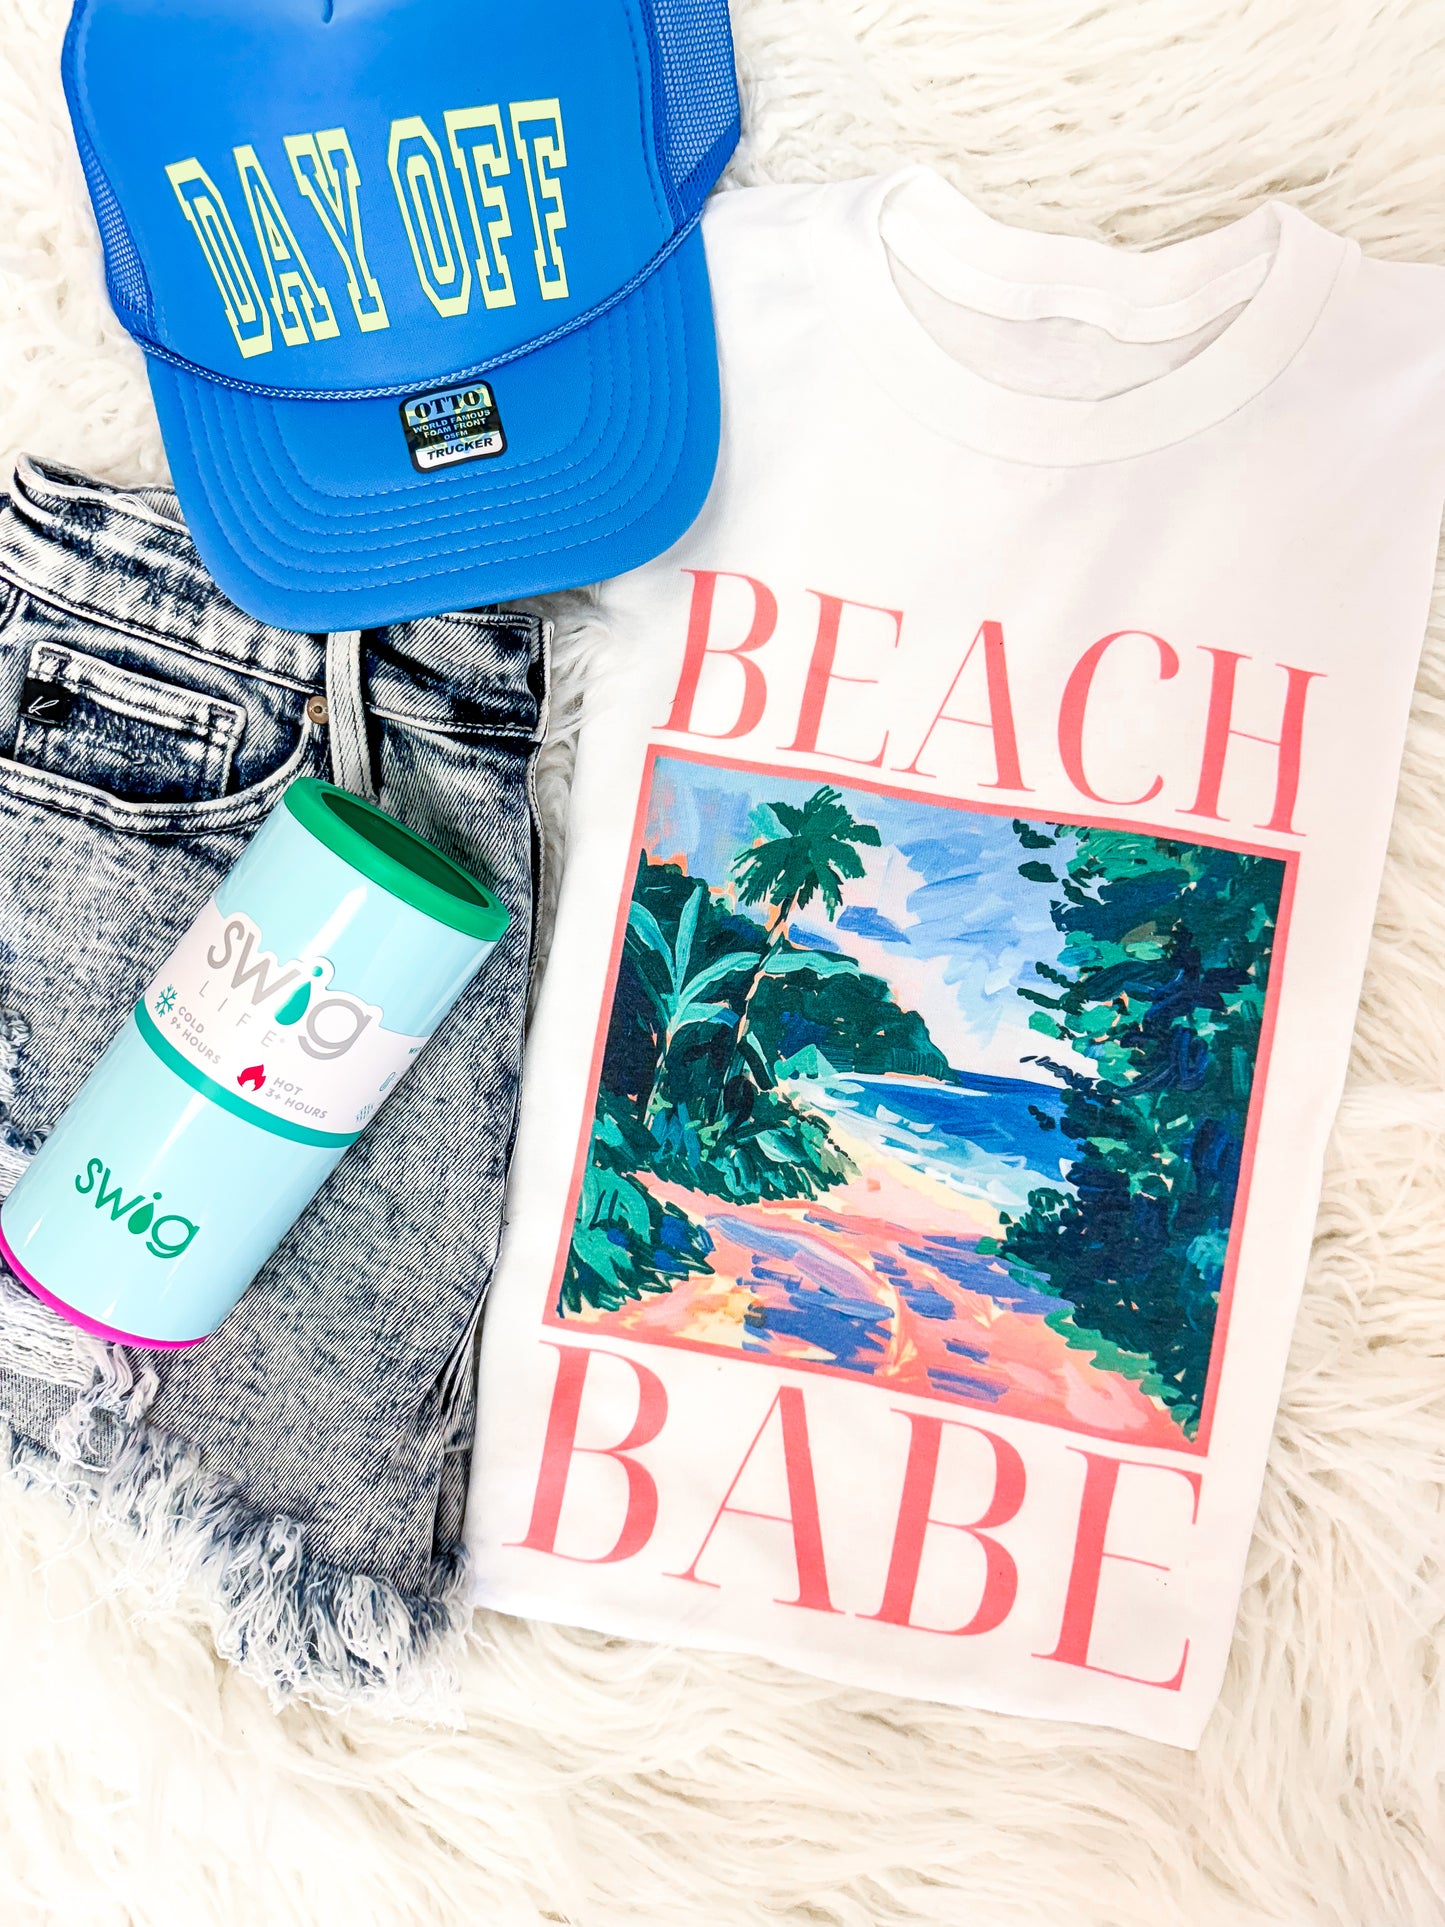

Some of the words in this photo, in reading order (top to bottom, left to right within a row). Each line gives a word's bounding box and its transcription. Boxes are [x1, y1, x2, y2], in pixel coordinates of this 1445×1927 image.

[165, 127, 390, 358] DAY
[388, 98, 570, 318] OFF
[414, 390, 480, 419] OTTO
[413, 419, 448, 434] WORLD
[451, 409, 491, 424] FAMOUS
[424, 425, 452, 438] FOAM
[454, 418, 486, 431] FRONT
[444, 430, 468, 440] OSFM
[427, 437, 493, 460] TRUCKER
[652, 568, 1328, 836] BEACH
[207, 920, 373, 1060] swig
[178, 1006, 205, 1034] COLD
[170, 1016, 181, 1030] 9+
[182, 1029, 221, 1065] HOURS
[273, 1077, 303, 1097] HOT
[265, 1088, 281, 1101] 3+
[284, 1095, 328, 1120] HOURS
[75, 1157, 200, 1259] swig
[502, 1340, 1203, 1692] BABE
